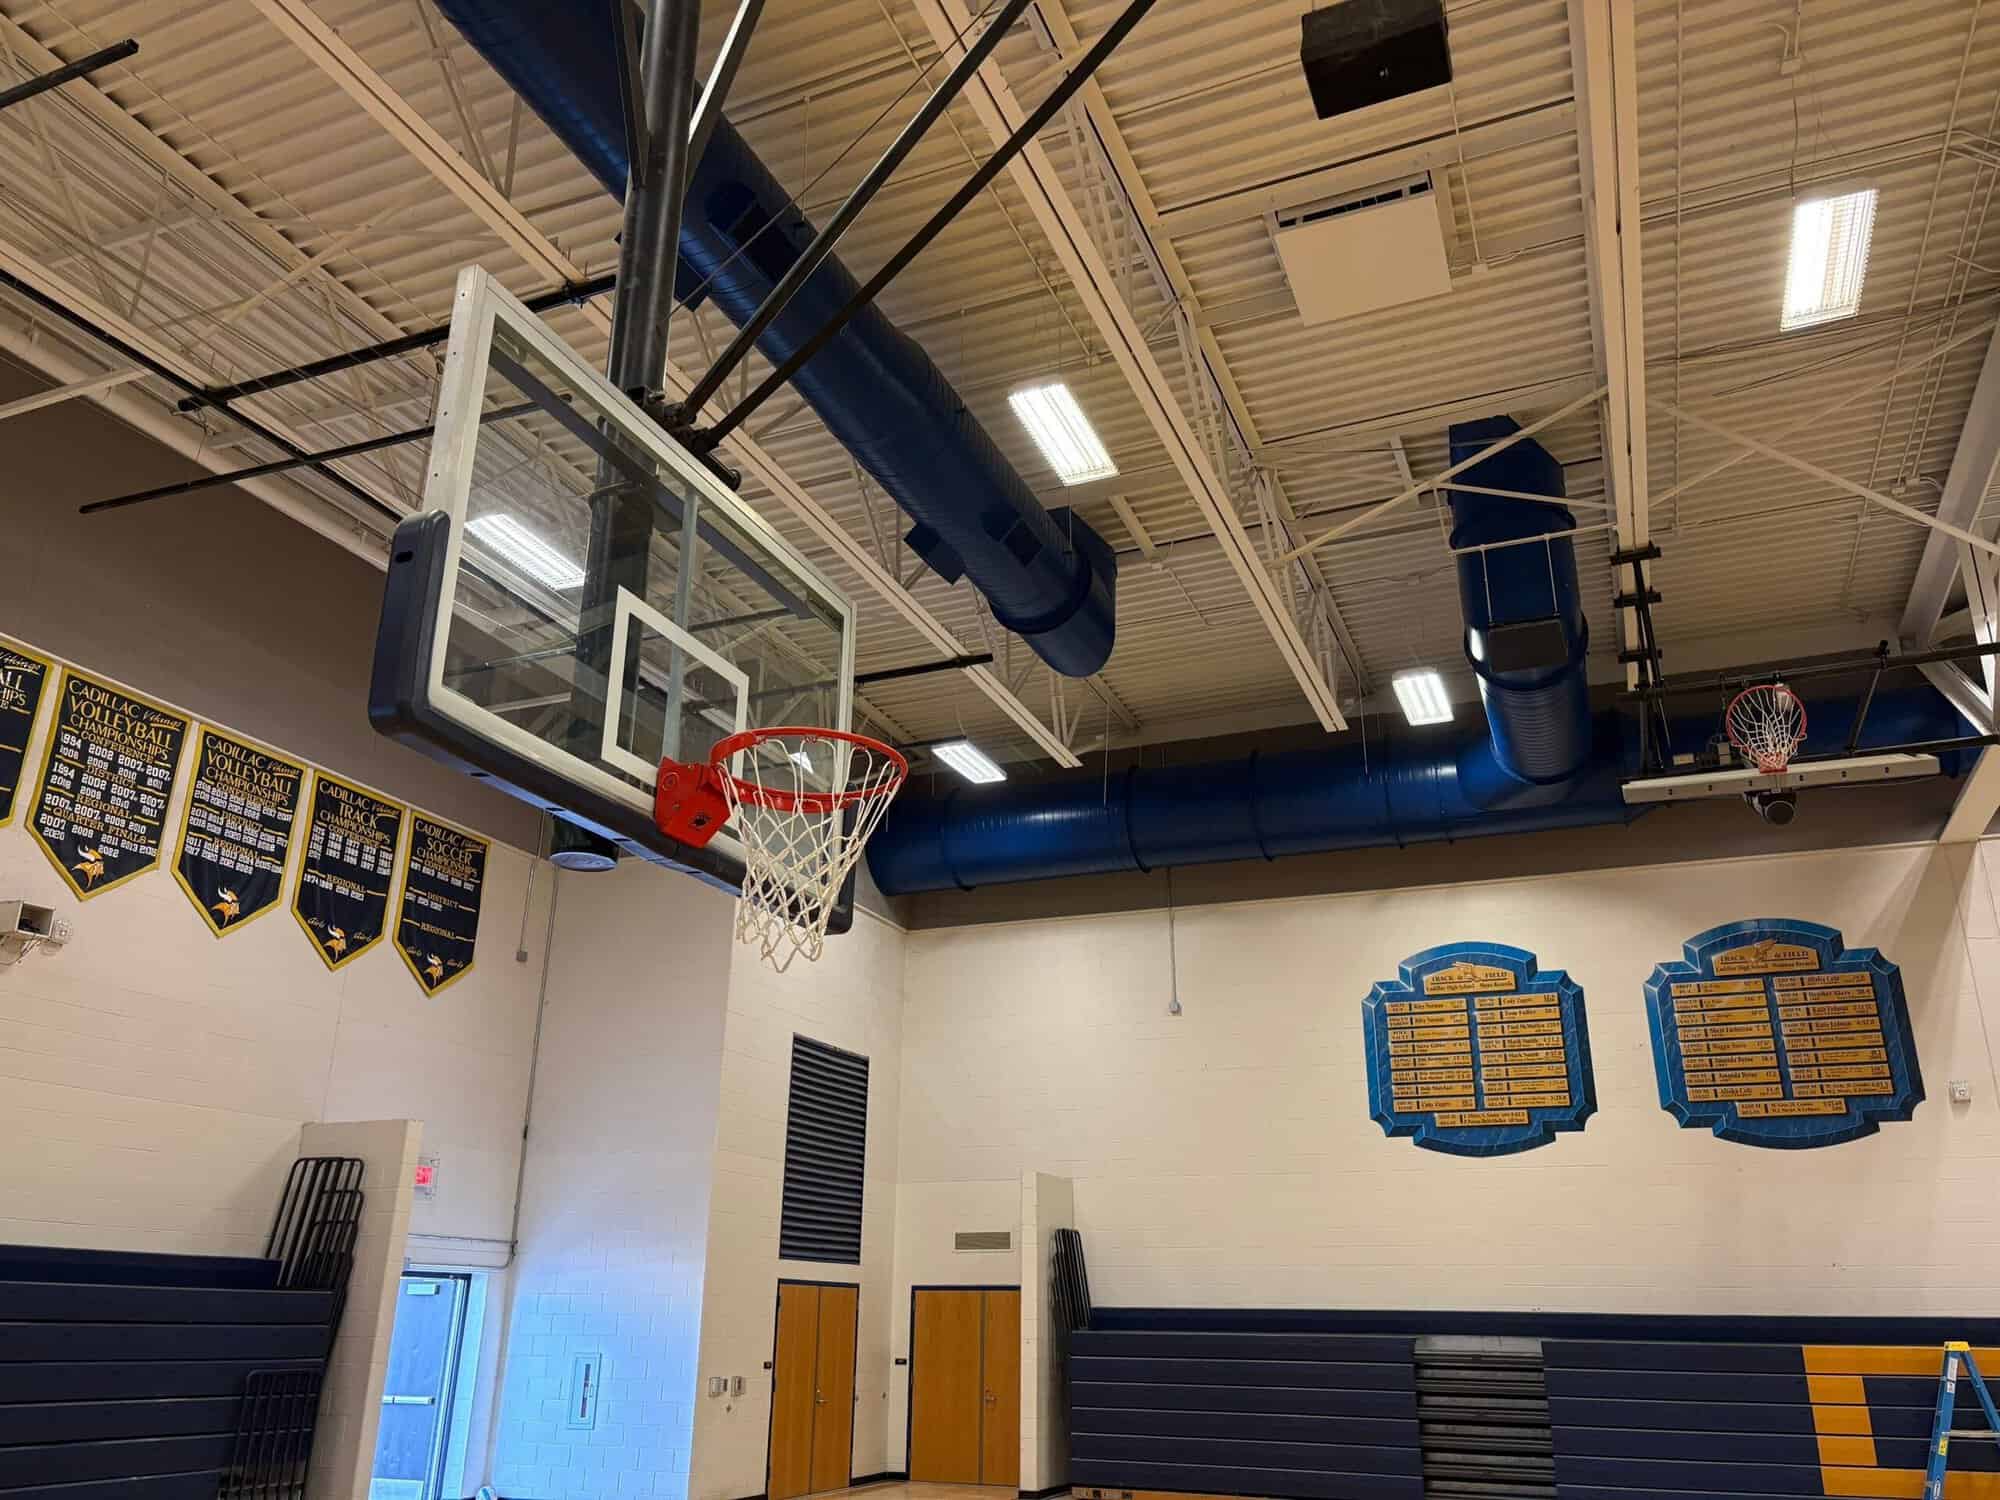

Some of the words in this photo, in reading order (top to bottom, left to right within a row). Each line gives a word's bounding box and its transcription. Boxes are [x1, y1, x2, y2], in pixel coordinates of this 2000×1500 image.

[69, 680, 141, 719] CADILLAC
[70, 714, 169, 760] CHAMPIONSHIPS
[71, 695, 174, 750] VOLLEYBALL
[81, 730, 155, 763] CONFERENCE
[88, 743, 114, 760] 2002
[206, 735, 266, 768] CADILLAC
[81, 774, 107, 790] 2002
[87, 765, 136, 788] DISTRICT
[206, 766, 288, 806] CHAMPIONSHIPS
[208, 750, 292, 796] VOLLEYBALL
[76, 793, 132, 819] REGIONAL
[320, 781, 370, 810] CADILLAC
[40, 814, 66, 830] 2007
[53, 807, 104, 832] QUARTER
[108, 825, 146, 844] FINALS
[320, 810, 391, 845] CHAMPIONSHIPS
[339, 802, 378, 829] TRACK
[415, 820, 460, 846] CADILLAC
[427, 837, 472, 865] SOCCER
